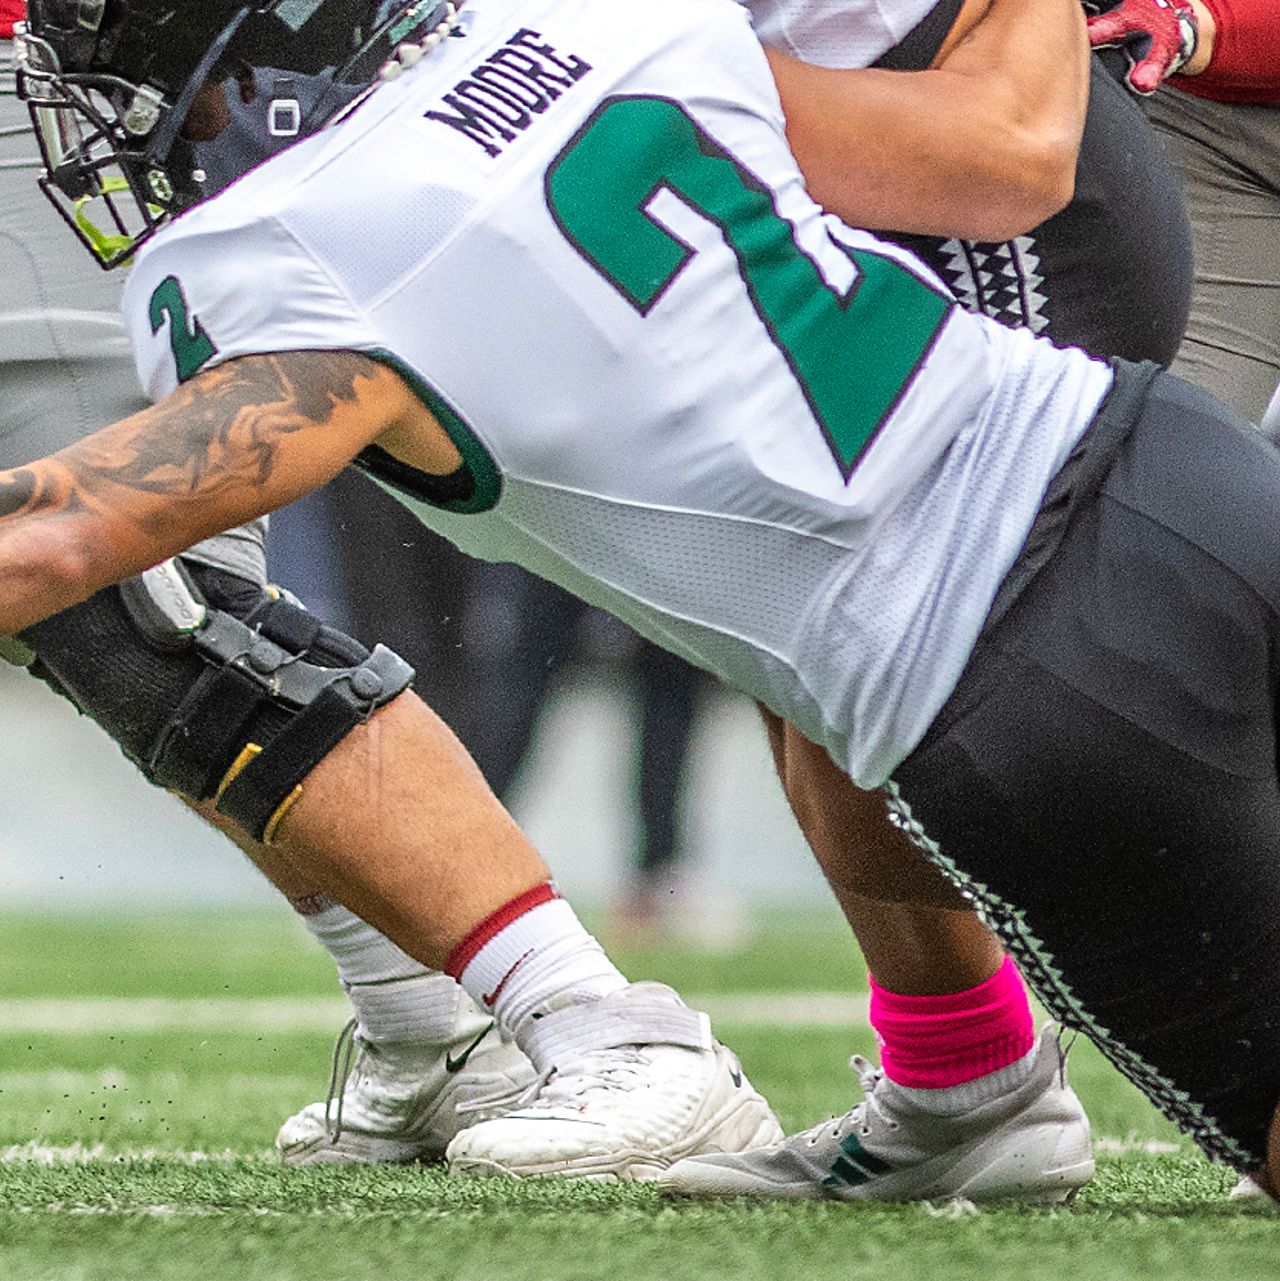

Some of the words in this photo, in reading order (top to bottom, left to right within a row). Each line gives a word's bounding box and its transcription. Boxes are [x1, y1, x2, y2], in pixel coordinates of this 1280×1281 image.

[422, 27, 594, 159] MOORE
[148, 274, 219, 386] 2
[543, 93, 959, 487] 2
